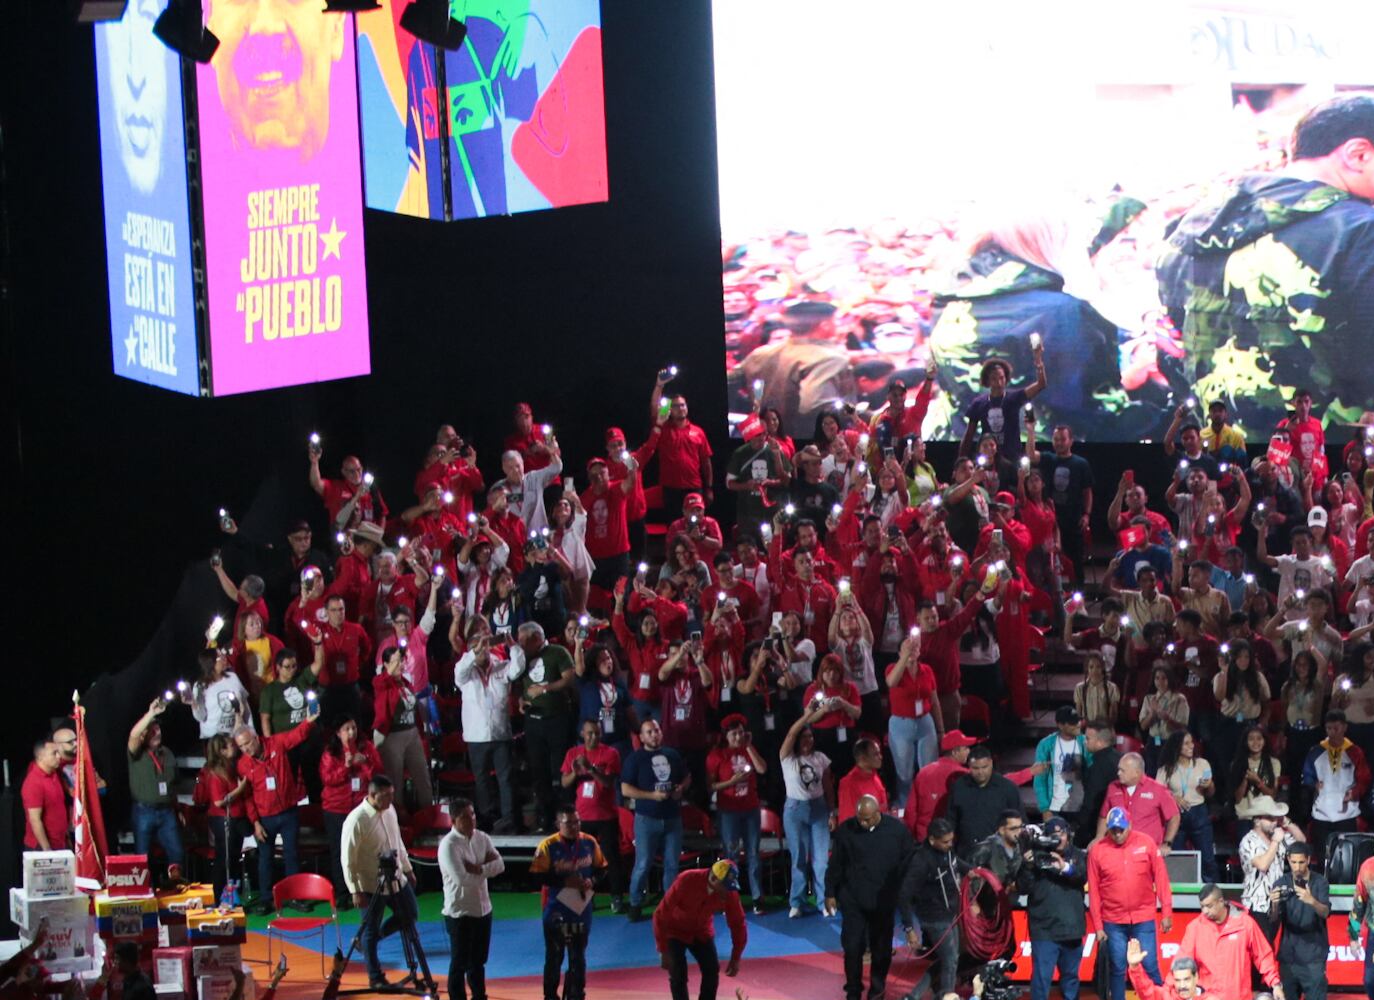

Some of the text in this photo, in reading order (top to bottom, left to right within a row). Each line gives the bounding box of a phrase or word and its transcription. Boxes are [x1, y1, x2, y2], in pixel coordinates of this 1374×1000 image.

[127, 211, 176, 257] ESPERANZA
[247, 184, 320, 229] SIEMPRE
[124, 253, 175, 314] ESTÁ EN
[240, 224, 317, 284] JUNTO
[244, 275, 342, 344] PUEBLO
[138, 314, 177, 376] CALLE
